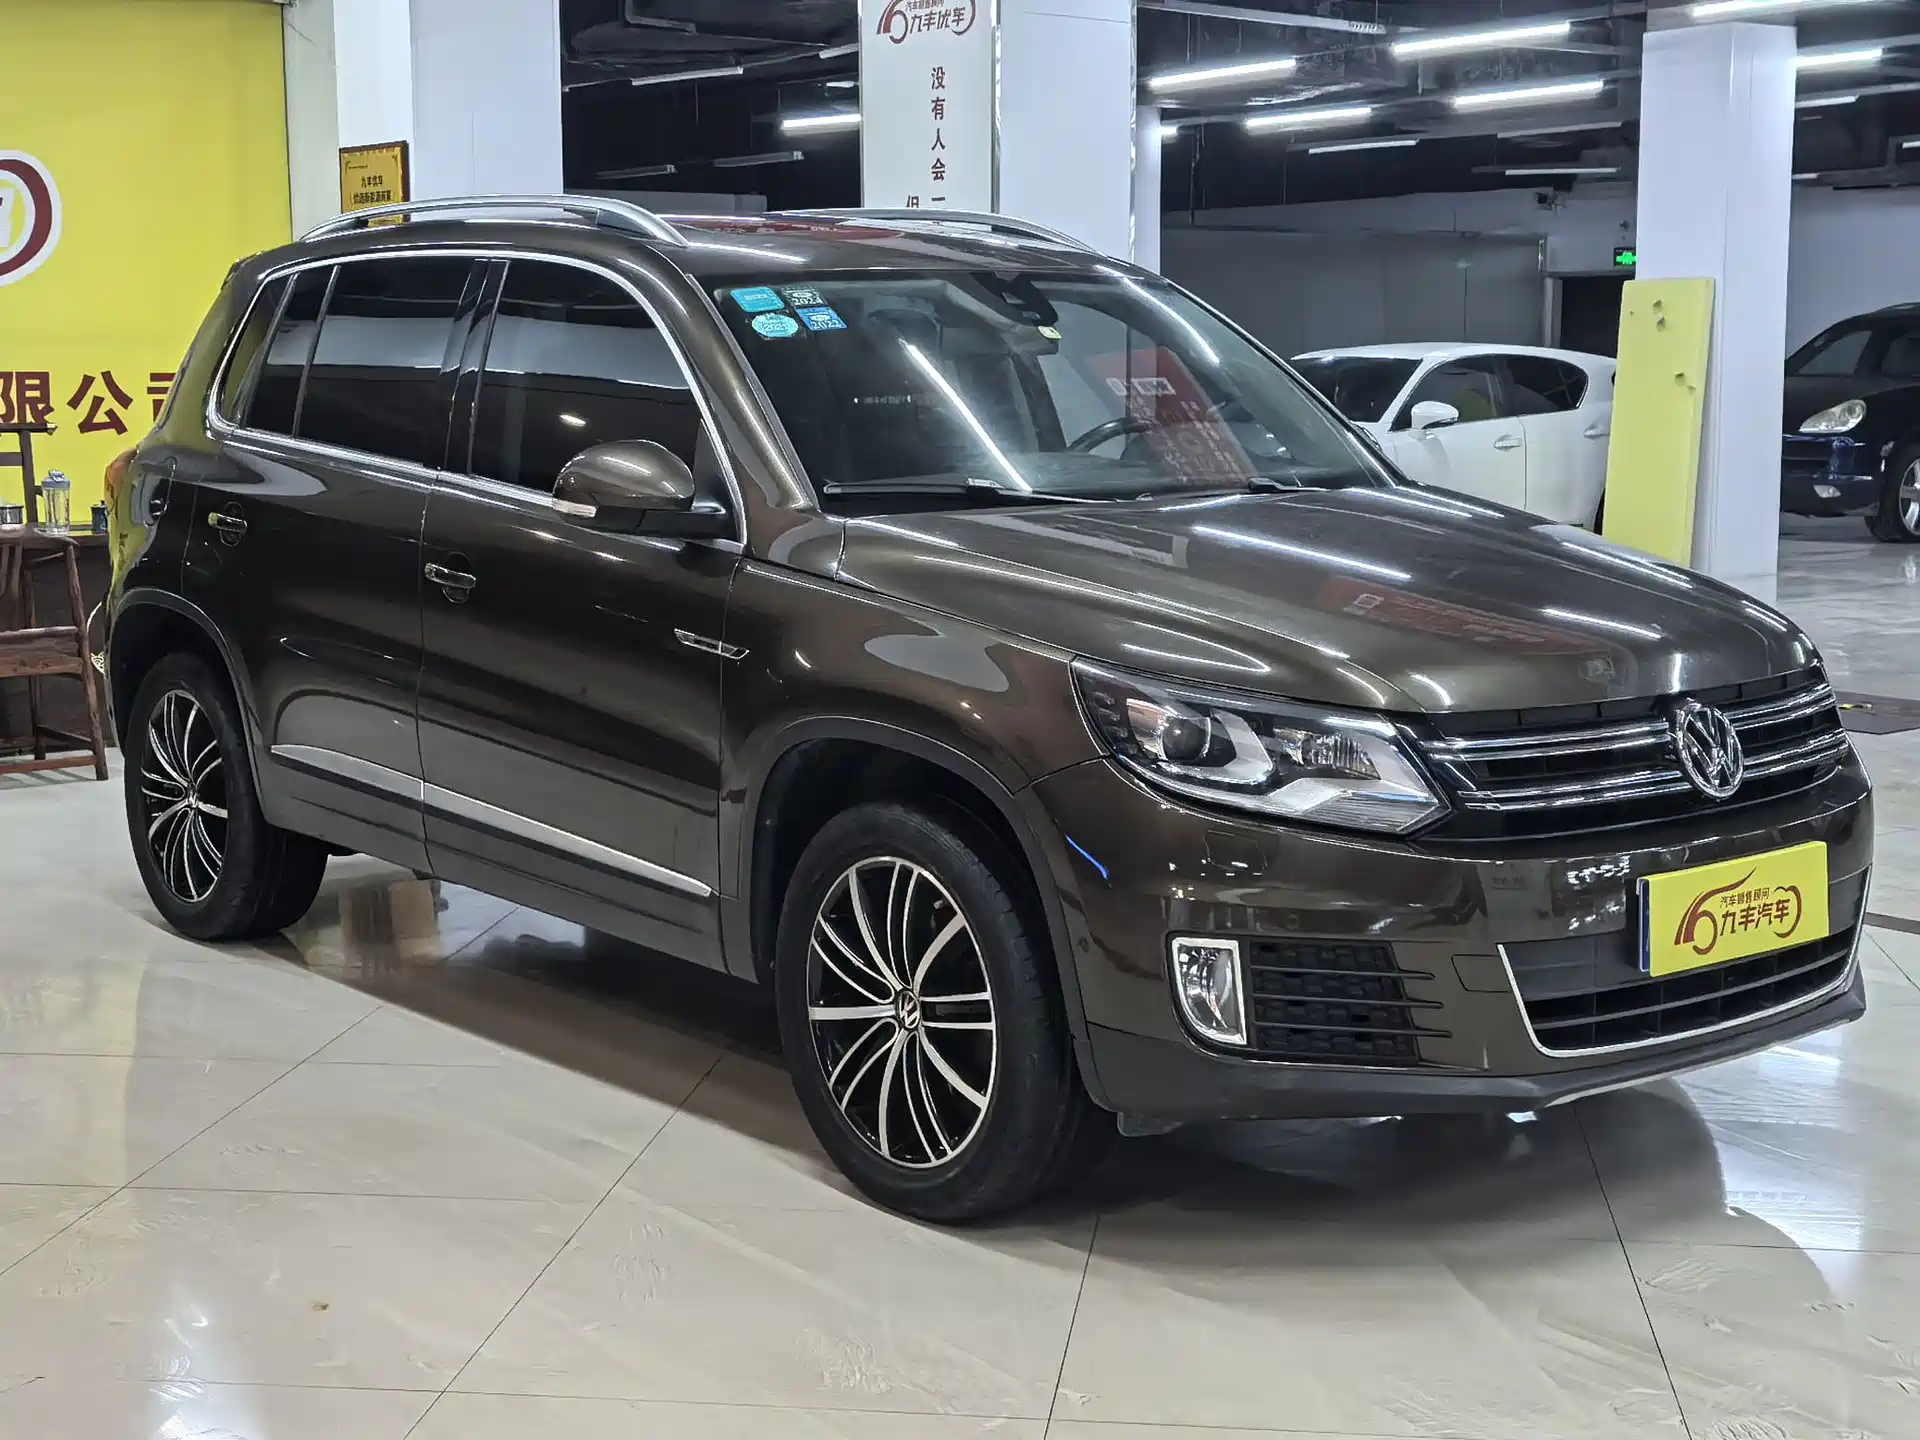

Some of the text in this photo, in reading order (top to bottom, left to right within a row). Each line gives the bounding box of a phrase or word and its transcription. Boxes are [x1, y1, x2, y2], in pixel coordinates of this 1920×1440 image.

[909, 6, 966, 35] 九丰优车
[811, 320, 842, 330] 2022
[1719, 886, 1771, 910] 汽车销售顾问
[1719, 898, 1791, 937] 九丰汽车
